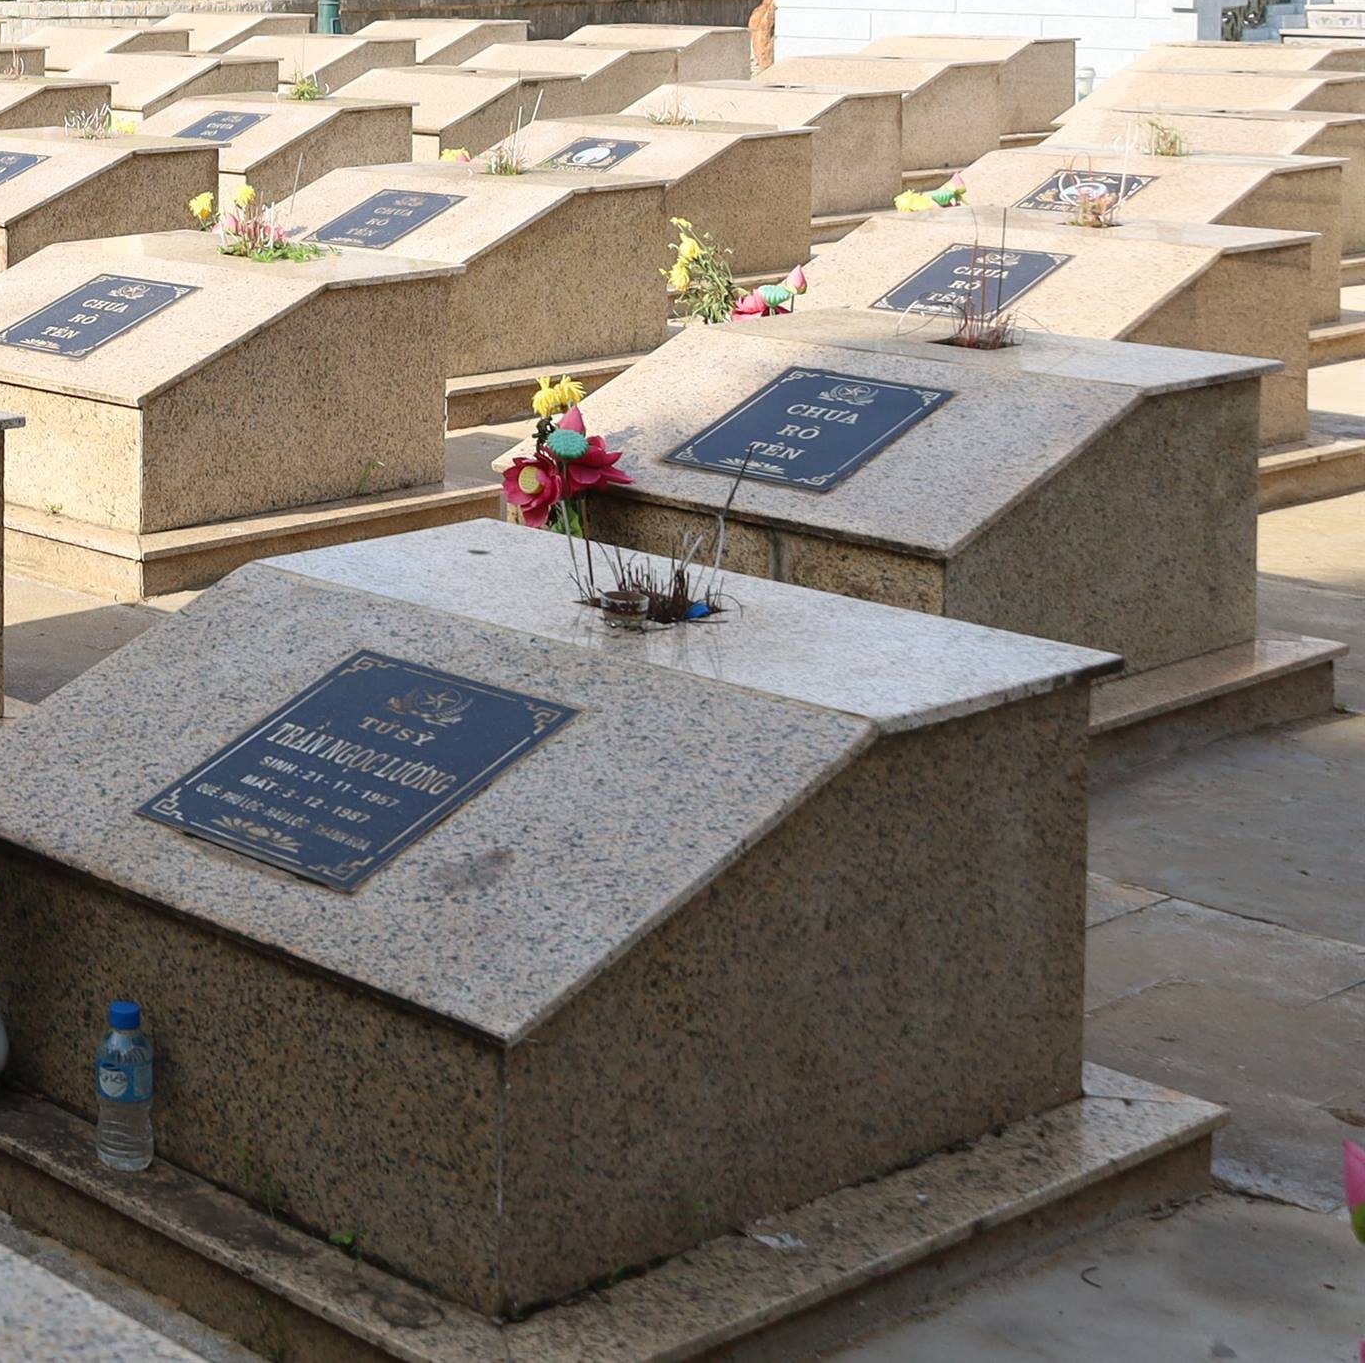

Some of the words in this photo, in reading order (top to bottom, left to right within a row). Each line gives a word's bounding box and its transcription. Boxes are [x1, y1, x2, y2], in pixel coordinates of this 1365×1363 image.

[82, 298, 129, 314] CHƯA
[67, 313, 100, 325] RÕ
[40, 325, 82, 339] TÊN
[786, 403, 859, 425] CHƯA
[775, 424, 821, 440] RÕ
[744, 441, 806, 461] TÊN
[259, 755, 299, 775] SINH
[266, 719, 334, 755] TRẦN
[318, 738, 388, 774] NGỌC
[373, 755, 457, 796] LƯƠNG
